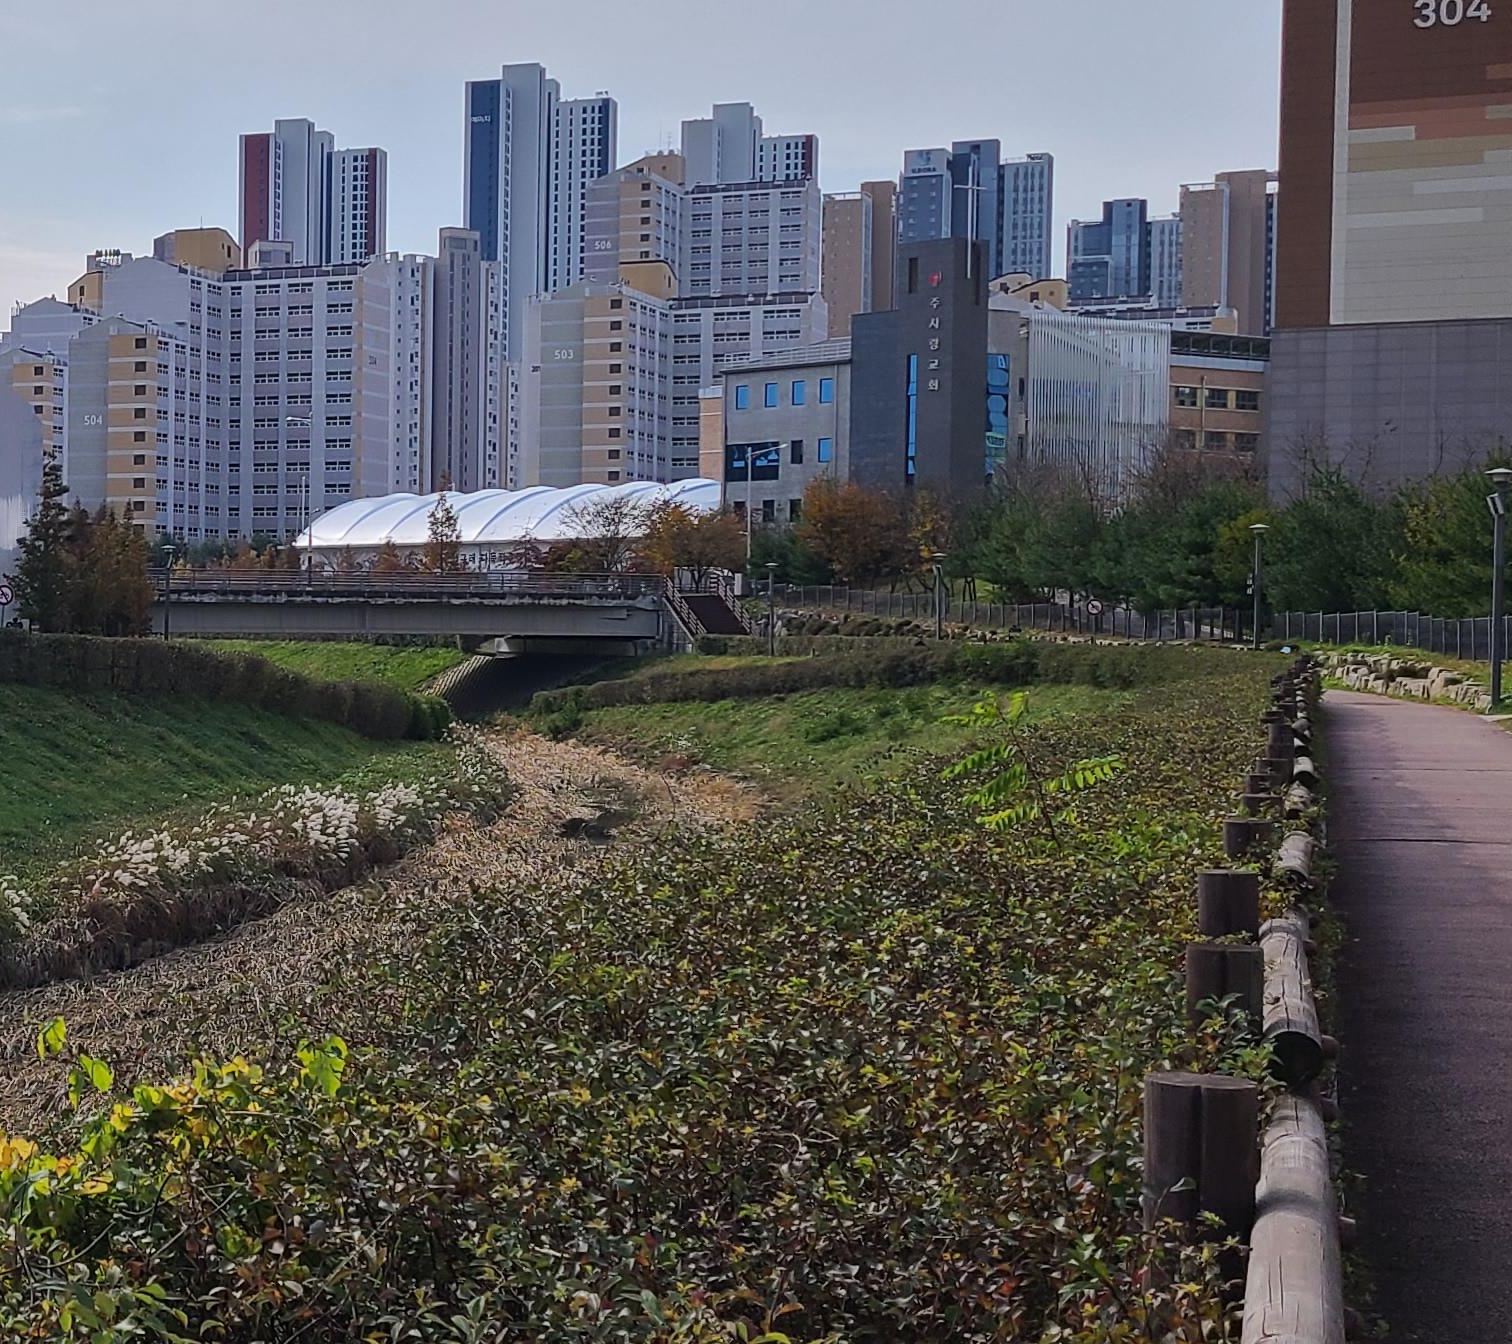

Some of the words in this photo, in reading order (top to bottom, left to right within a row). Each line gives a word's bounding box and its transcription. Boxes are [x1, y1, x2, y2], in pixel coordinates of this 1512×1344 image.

[594, 240, 612, 250] 506
[554, 349, 574, 360] 503
[84, 414, 103, 425] 504
